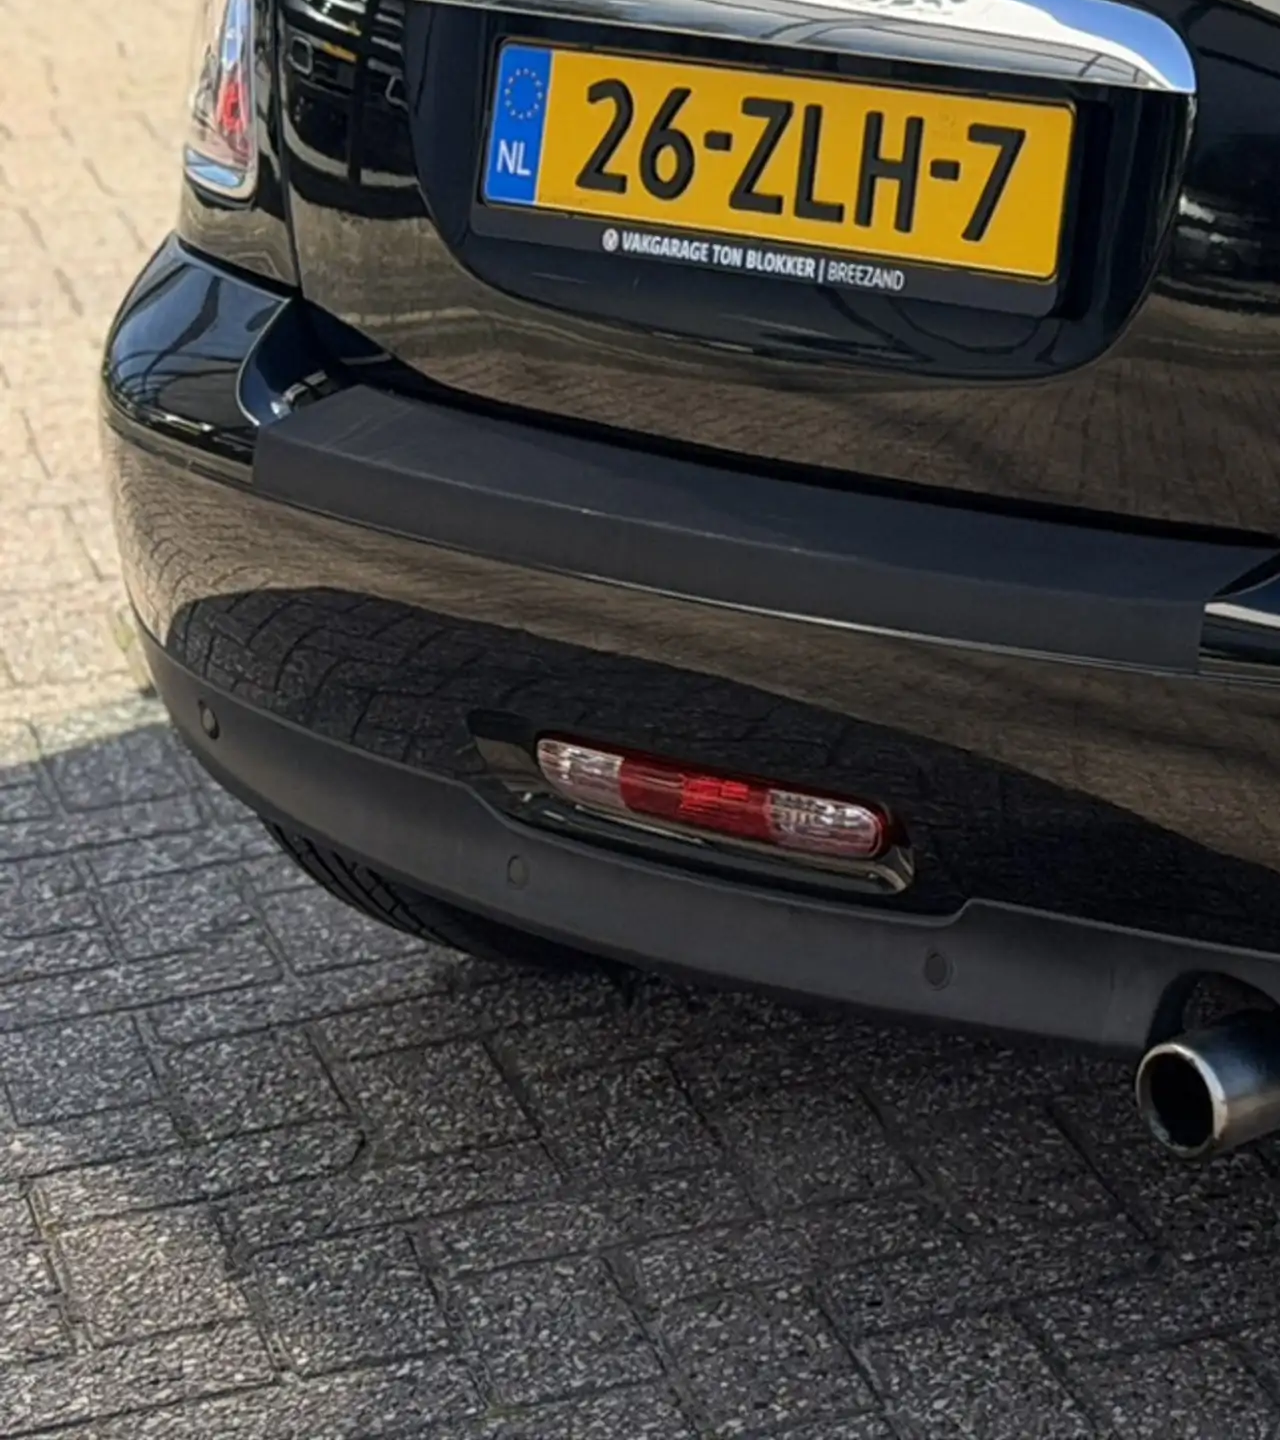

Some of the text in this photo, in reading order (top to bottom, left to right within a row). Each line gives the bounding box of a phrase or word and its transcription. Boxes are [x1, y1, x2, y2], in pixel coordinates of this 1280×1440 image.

[498, 140, 531, 177] NL
[575, 79, 1026, 242] 26-ZLH-7
[622, 231, 904, 291] VAKGARAGE TON BLOKKER BREEZAND
